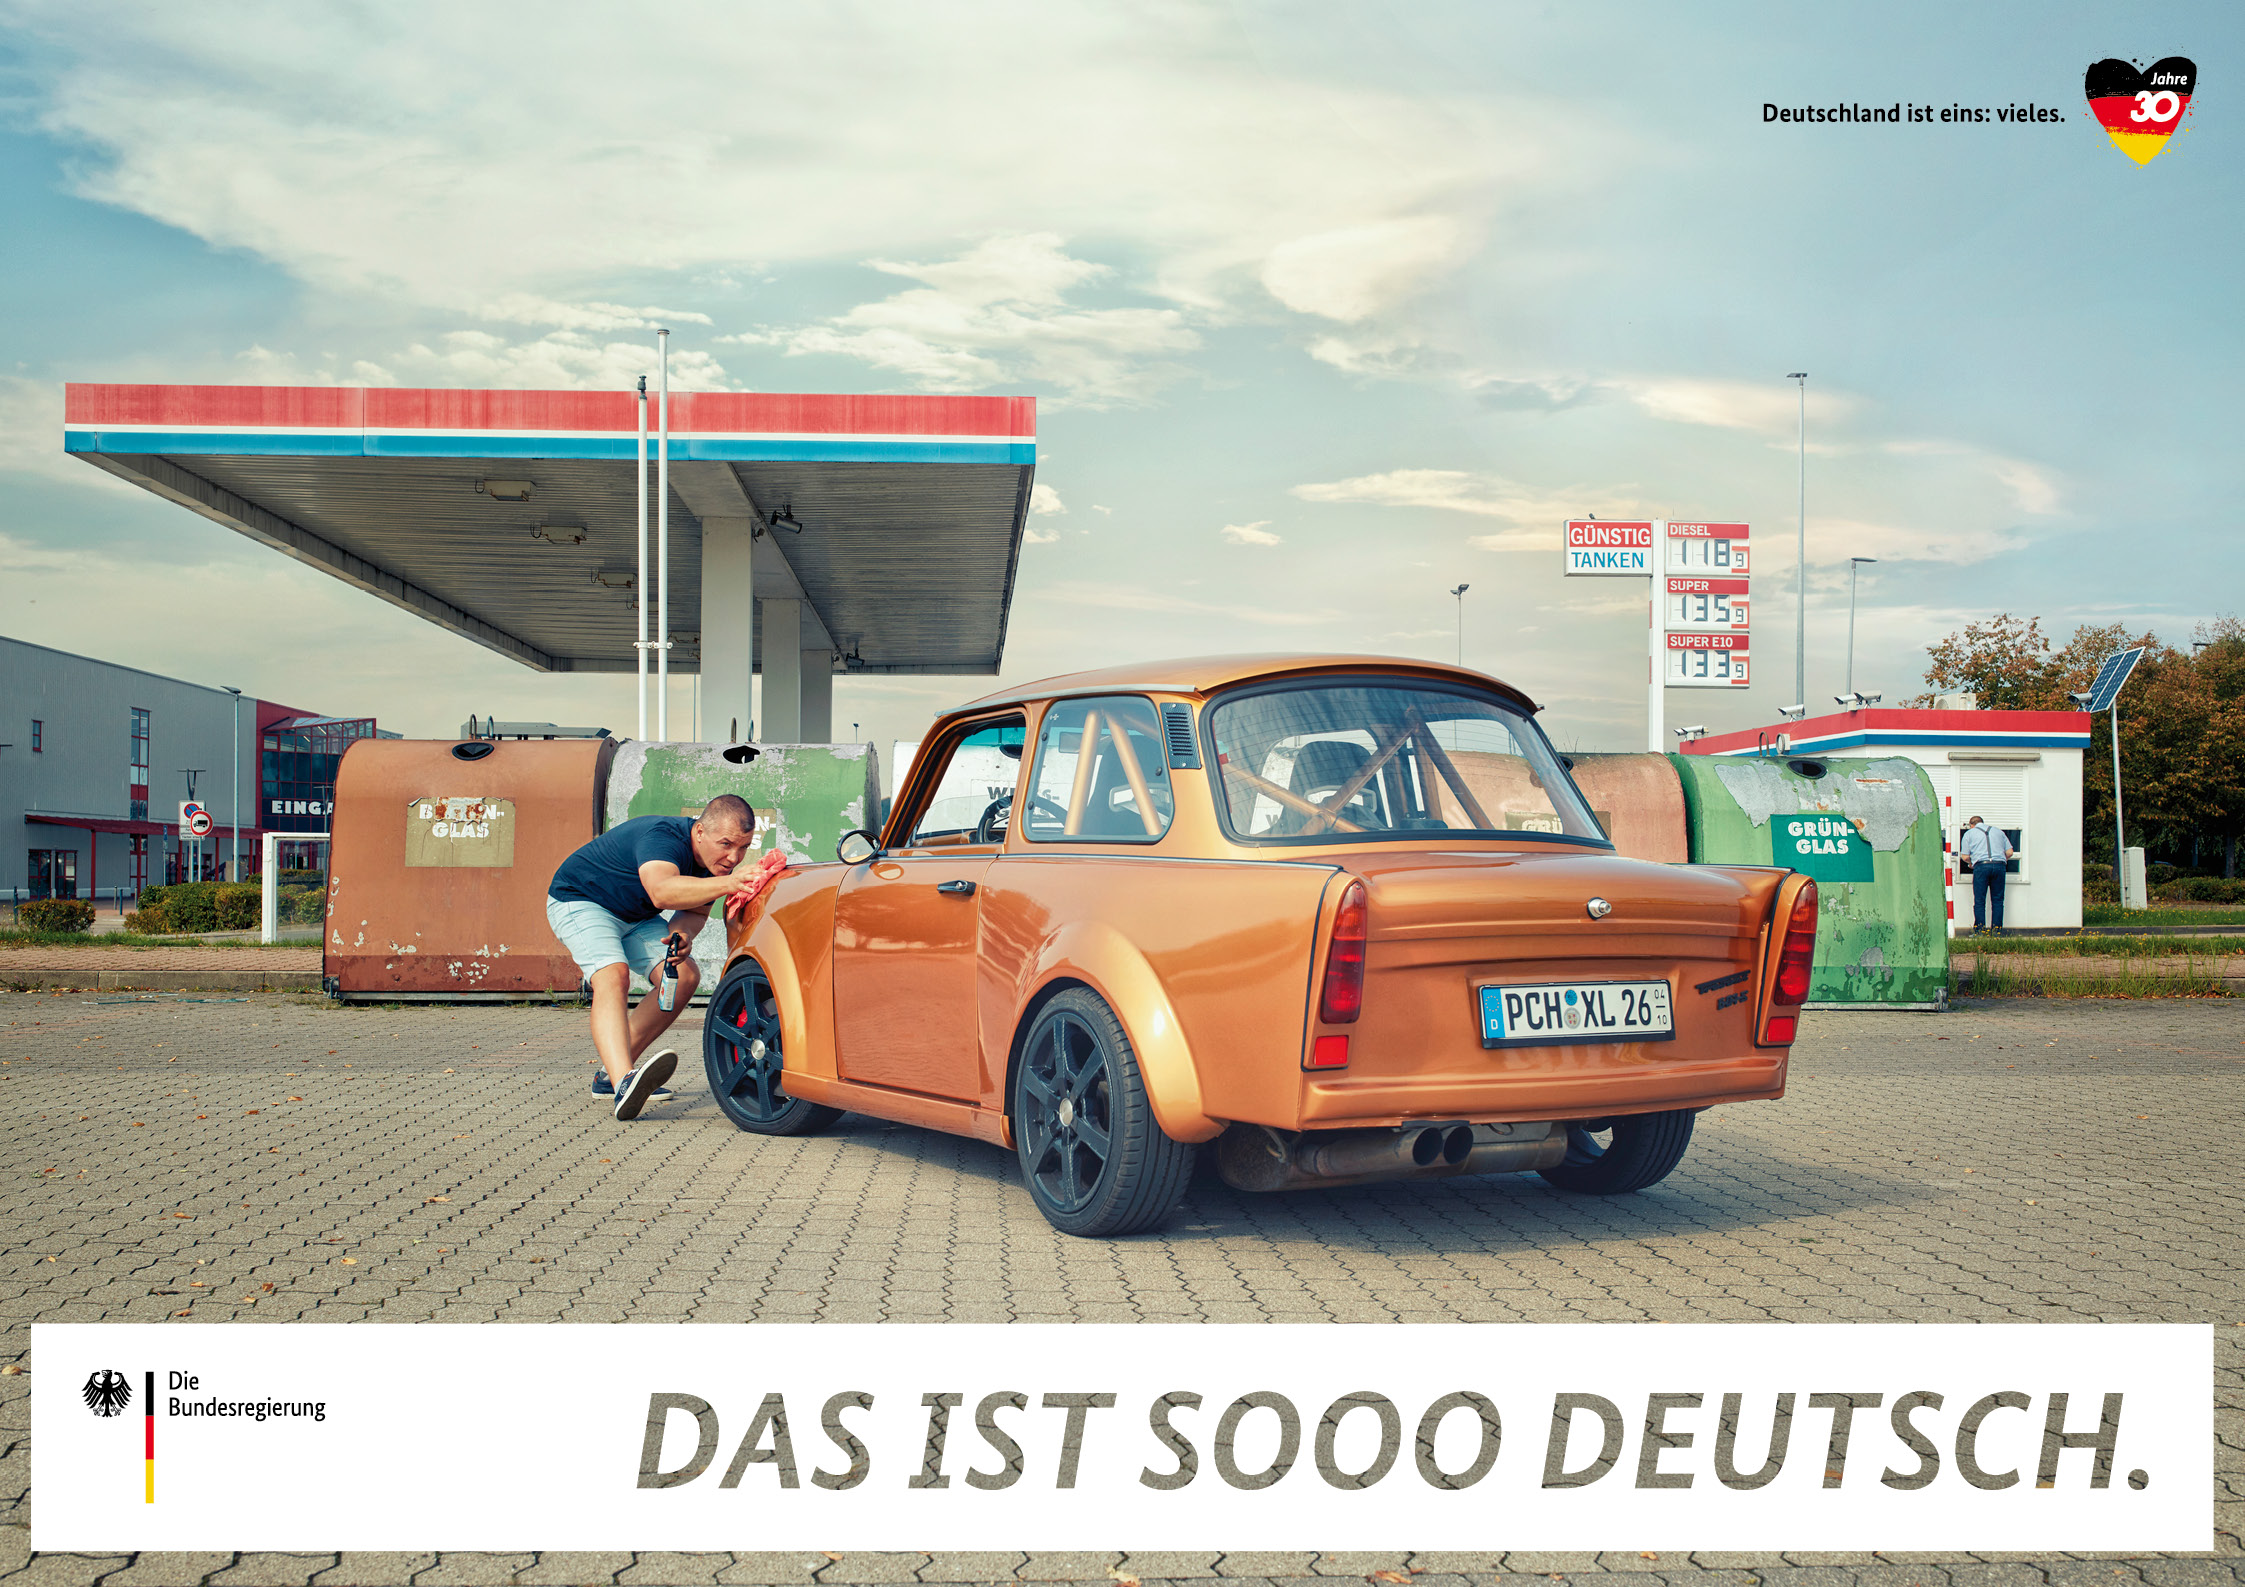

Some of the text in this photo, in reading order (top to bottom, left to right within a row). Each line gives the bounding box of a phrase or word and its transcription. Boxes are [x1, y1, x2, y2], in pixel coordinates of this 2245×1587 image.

[1570, 524, 1651, 545] GÜNSTIG
[1669, 524, 1711, 536] DIESEL
[1571, 551, 1644, 568] TANKEN
[1670, 580, 1709, 591] SUPER
[1670, 636, 1734, 648] SUPER E10
[431, 821, 490, 838] GLAS
[1787, 817, 1855, 837] GRÜN-
[1795, 839, 1849, 855] GLAS
[1654, 988, 1665, 1000] 04
[1490, 989, 1652, 1031] D PCH XL 26
[1657, 1014, 1668, 1026] 10
